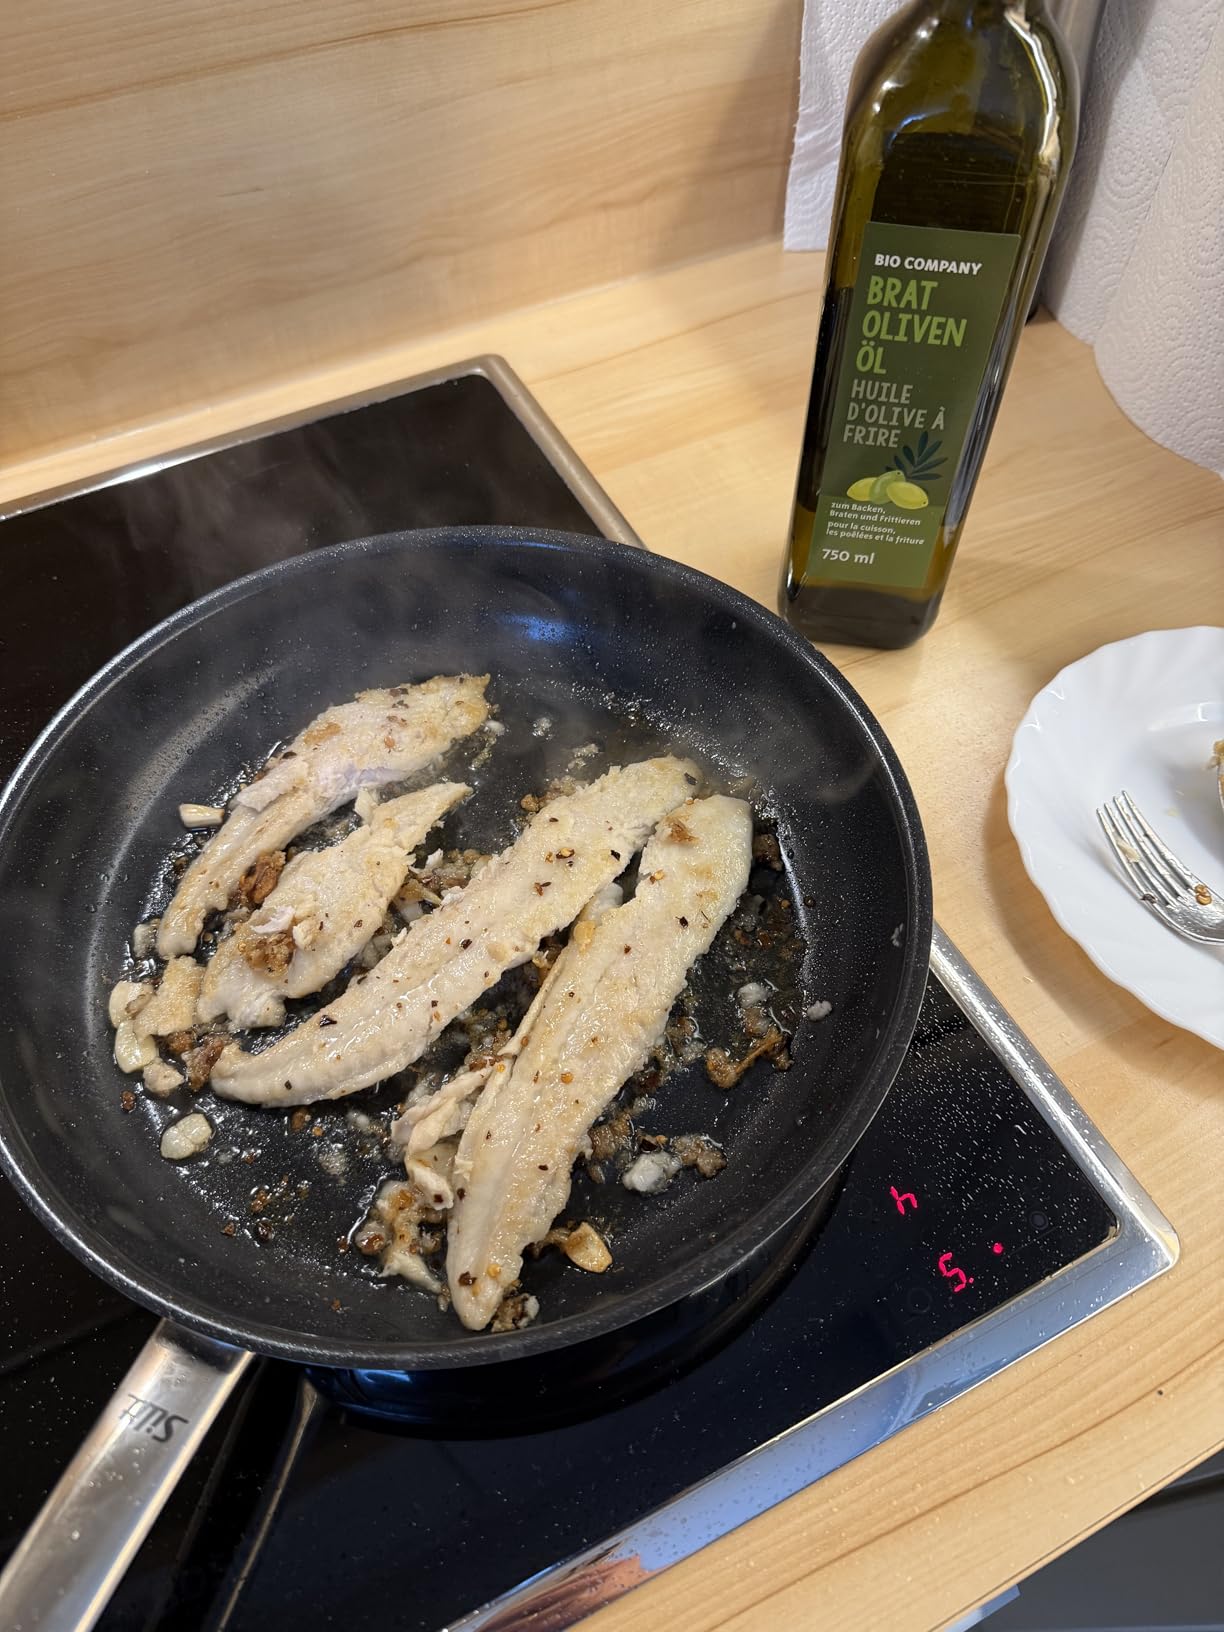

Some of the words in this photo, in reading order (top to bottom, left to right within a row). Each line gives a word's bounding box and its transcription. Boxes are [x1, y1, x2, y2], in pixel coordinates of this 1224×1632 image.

[874, 253, 901, 268] BIO
[904, 256, 982, 276] COMPANY
[866, 275, 938, 311] BRAT
[862, 310, 967, 347] OLIVEN
[856, 340, 887, 375] ÖL
[851, 379, 914, 404] HUILE
[847, 402, 928, 429] D'OLIVE
[931, 406, 946, 430] À
[842, 425, 901, 448] FRIRE
[829, 510, 858, 520] Braten
[860, 513, 877, 522] und
[879, 515, 921, 526] Frittieren
[831, 502, 851, 510] zum
[851, 503, 886, 514] Backen,
[826, 528, 838, 537] les
[874, 533, 884, 541] et
[885, 534, 894, 542] la
[895, 535, 925, 545] friture
[827, 521, 849, 531] pour
[850, 522, 858, 530] la
[860, 524, 896, 535] cuisson,
[822, 548, 850, 562] 750
[854, 552, 875, 565] ml
